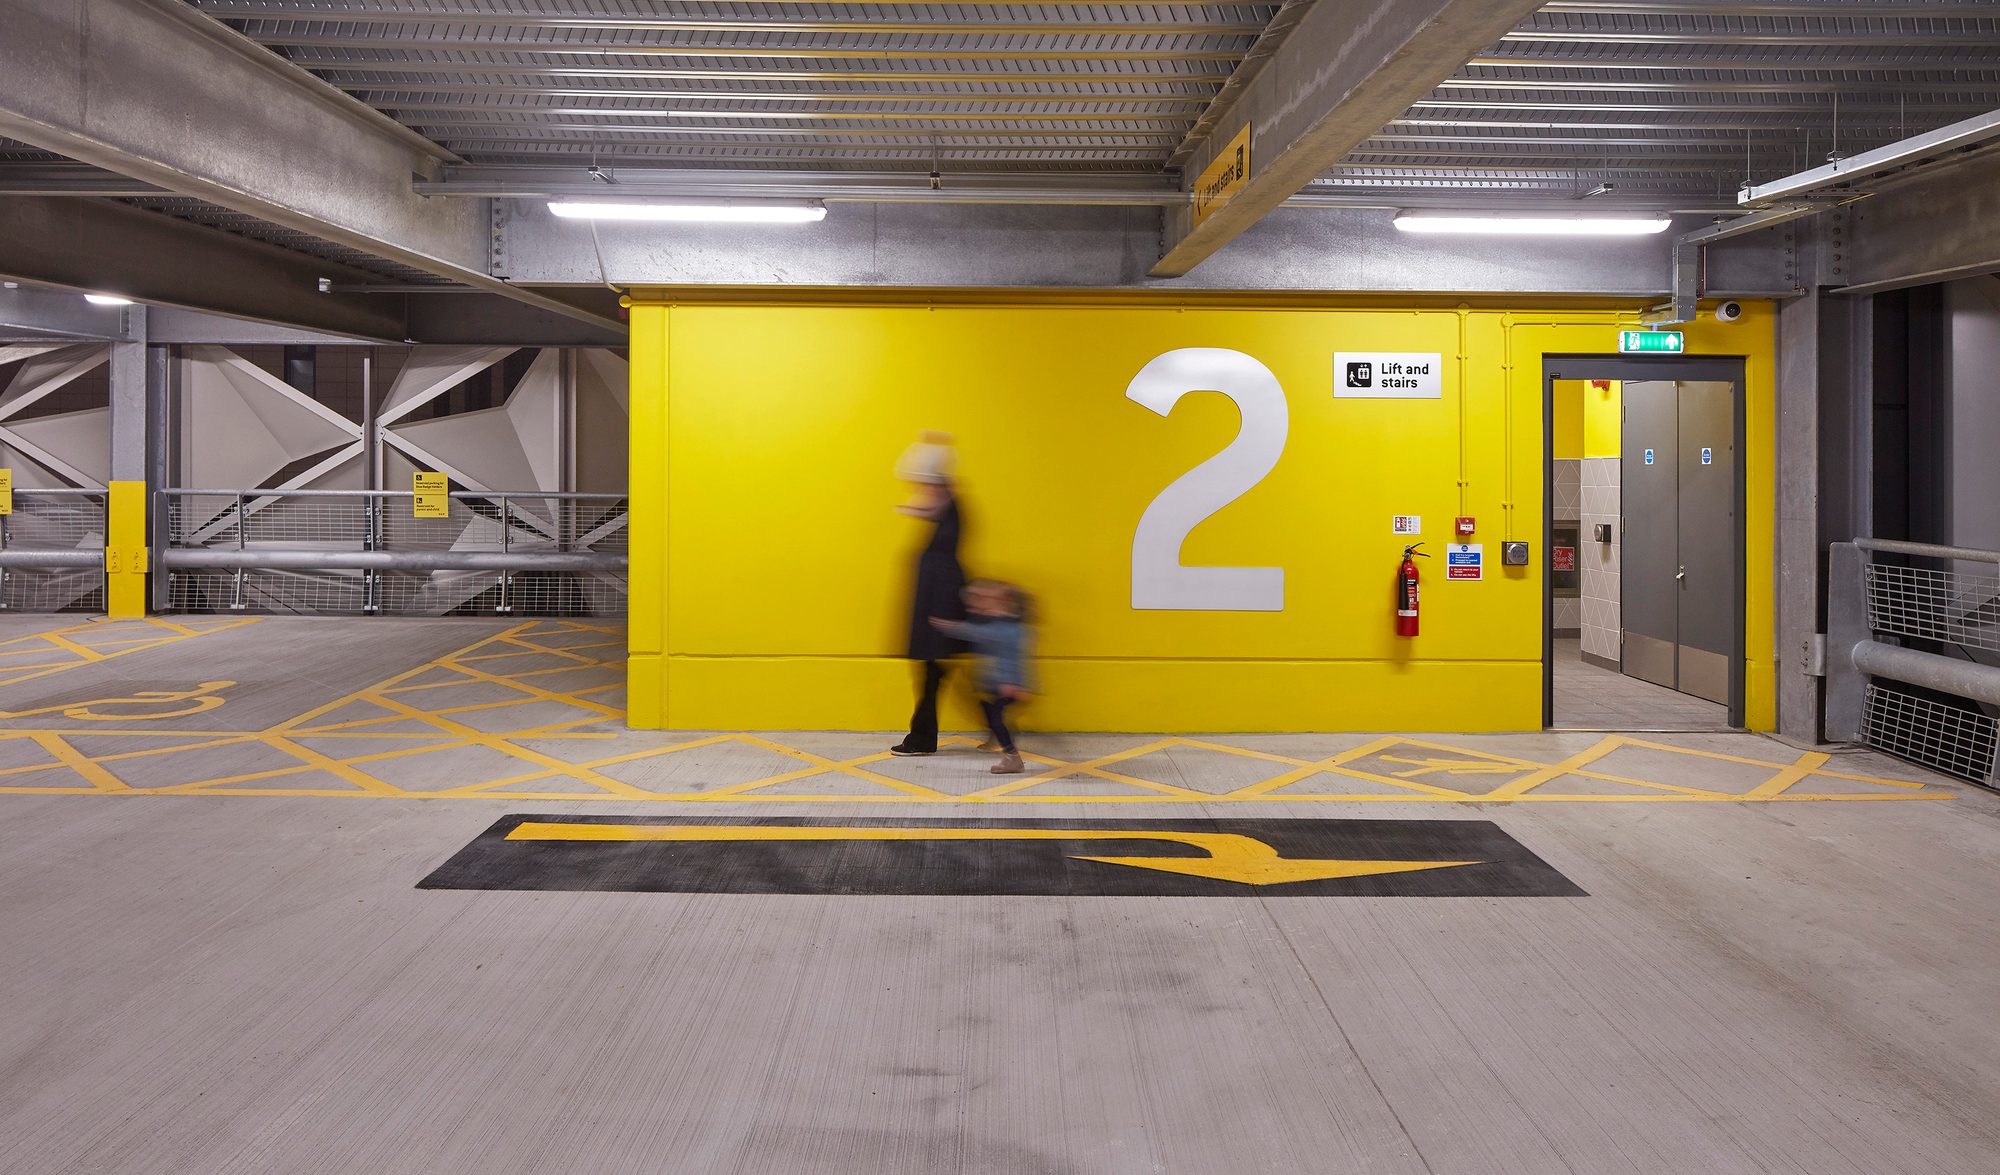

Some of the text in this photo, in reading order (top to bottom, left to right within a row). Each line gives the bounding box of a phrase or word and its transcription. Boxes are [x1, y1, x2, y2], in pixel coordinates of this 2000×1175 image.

[1212, 174, 1220, 199] and
[1221, 164, 1234, 191] stairs
[1381, 363, 1429, 375] Lift and
[1381, 377, 1418, 388] stairs
[1125, 347, 1289, 611] 2
